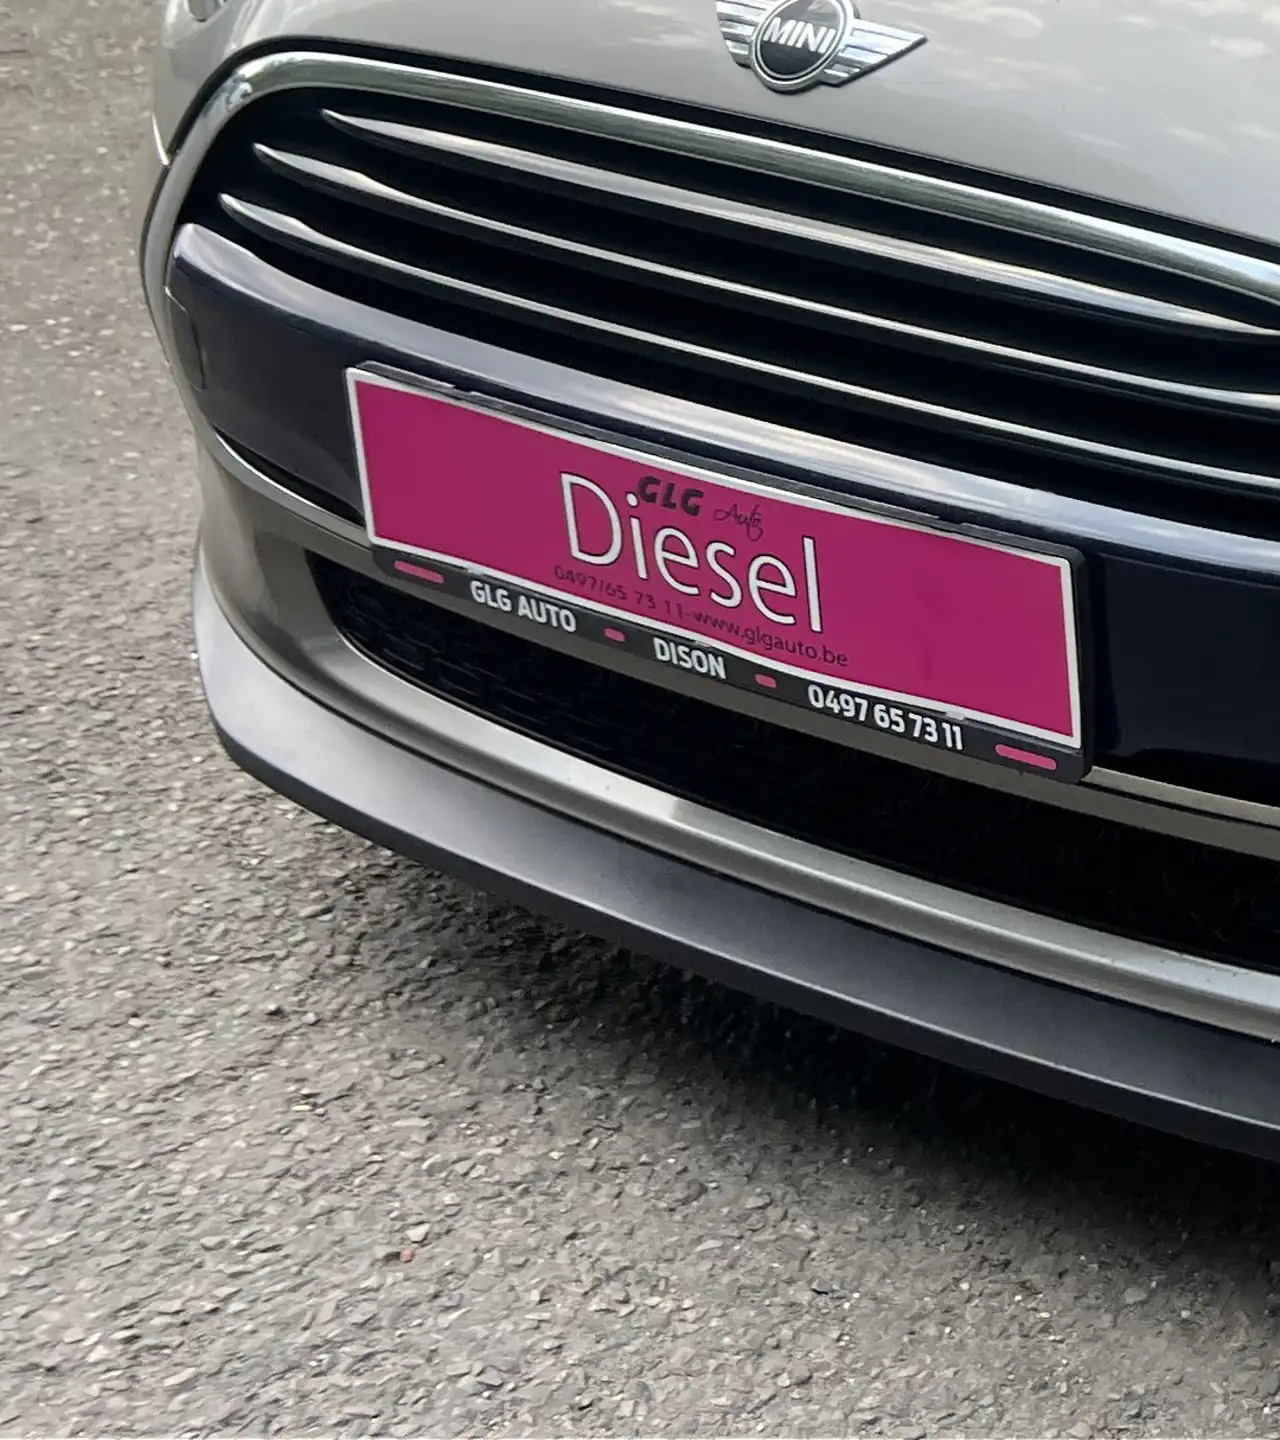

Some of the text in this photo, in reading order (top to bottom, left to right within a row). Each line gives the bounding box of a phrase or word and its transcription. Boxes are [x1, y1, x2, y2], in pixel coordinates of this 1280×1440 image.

[762, 16, 837, 54] MINI
[637, 475, 765, 542] GLG Auto
[560, 471, 823, 634] Diesel
[634, 590, 657, 610] 73
[469, 580, 964, 751] GLG AUTO DISON 0497 65 73 11
